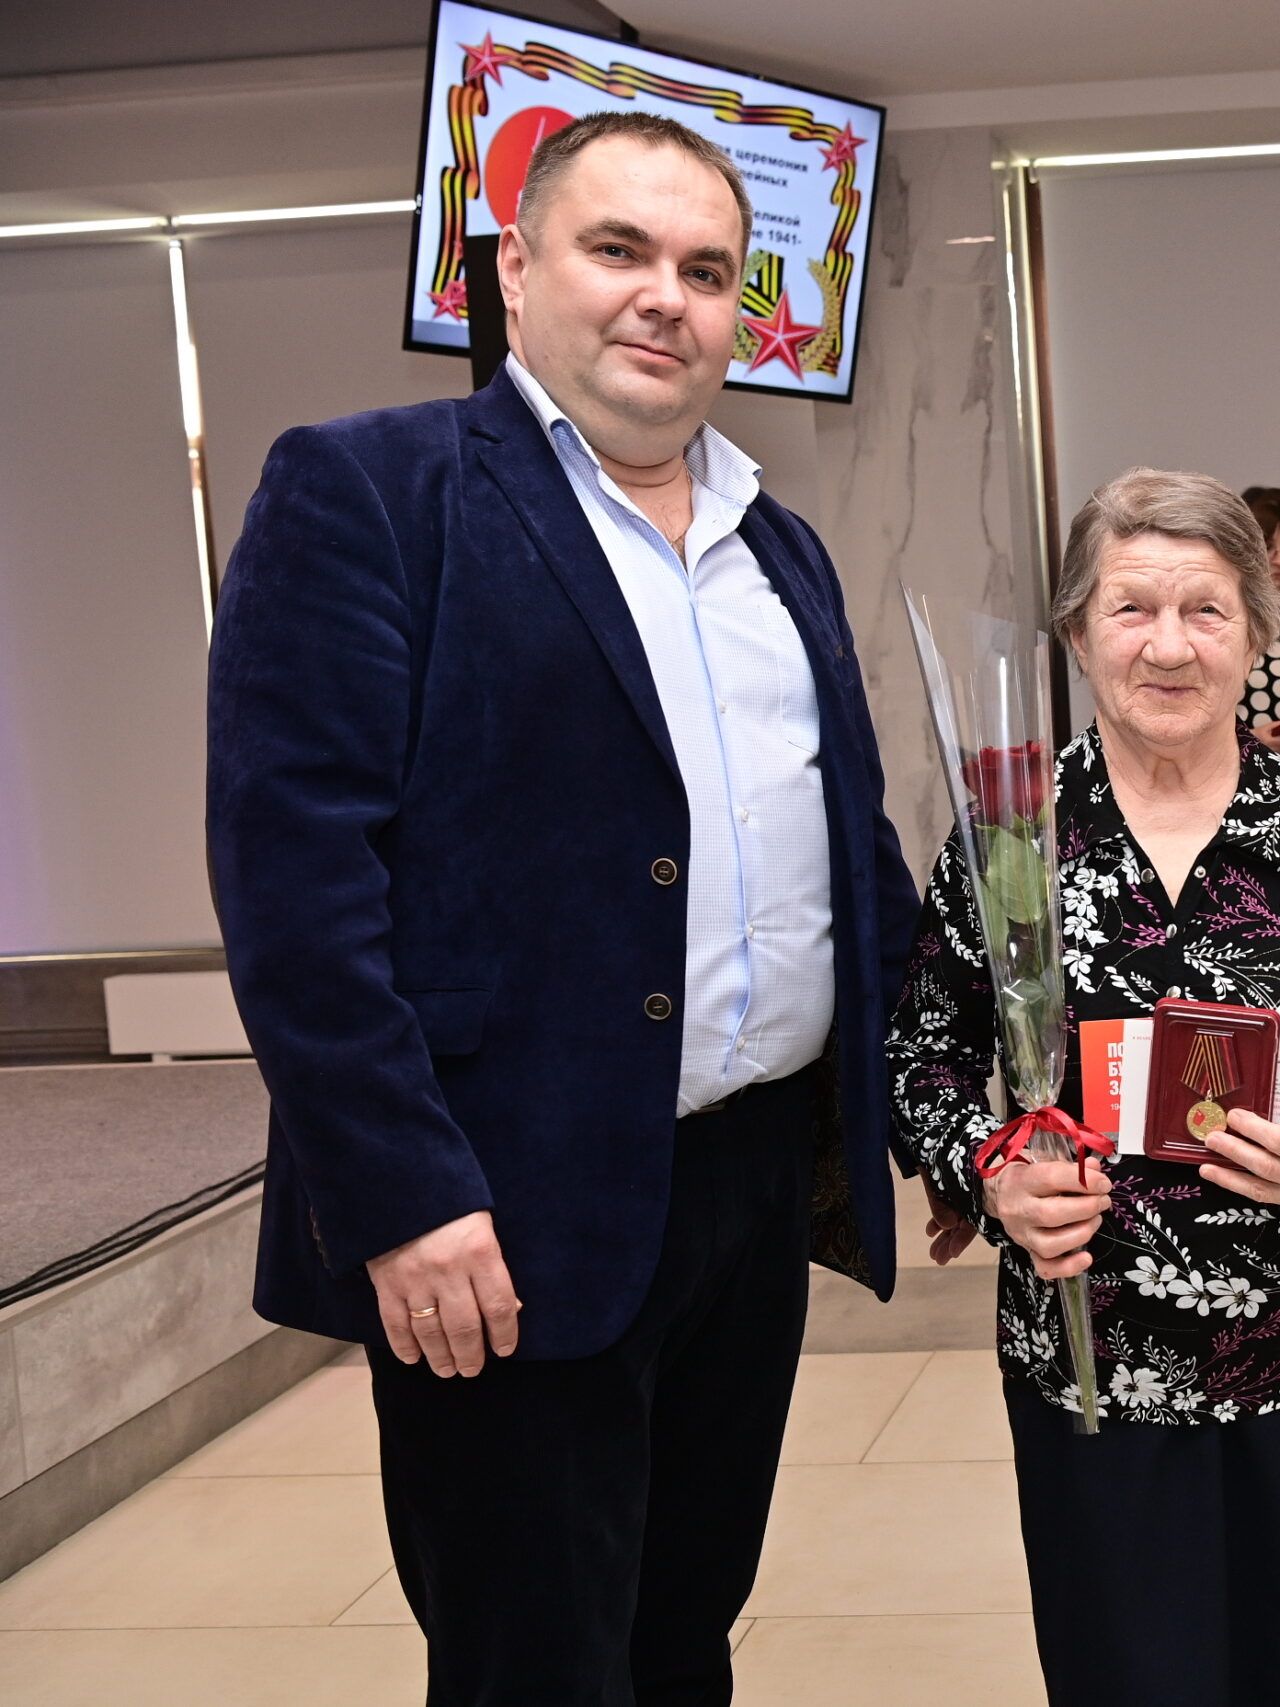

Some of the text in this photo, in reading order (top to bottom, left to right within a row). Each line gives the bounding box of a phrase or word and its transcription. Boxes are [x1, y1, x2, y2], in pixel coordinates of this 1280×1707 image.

[735, 149, 808, 172] церемония
[754, 210, 801, 228] еликой
[1109, 1079, 1121, 1096] З
